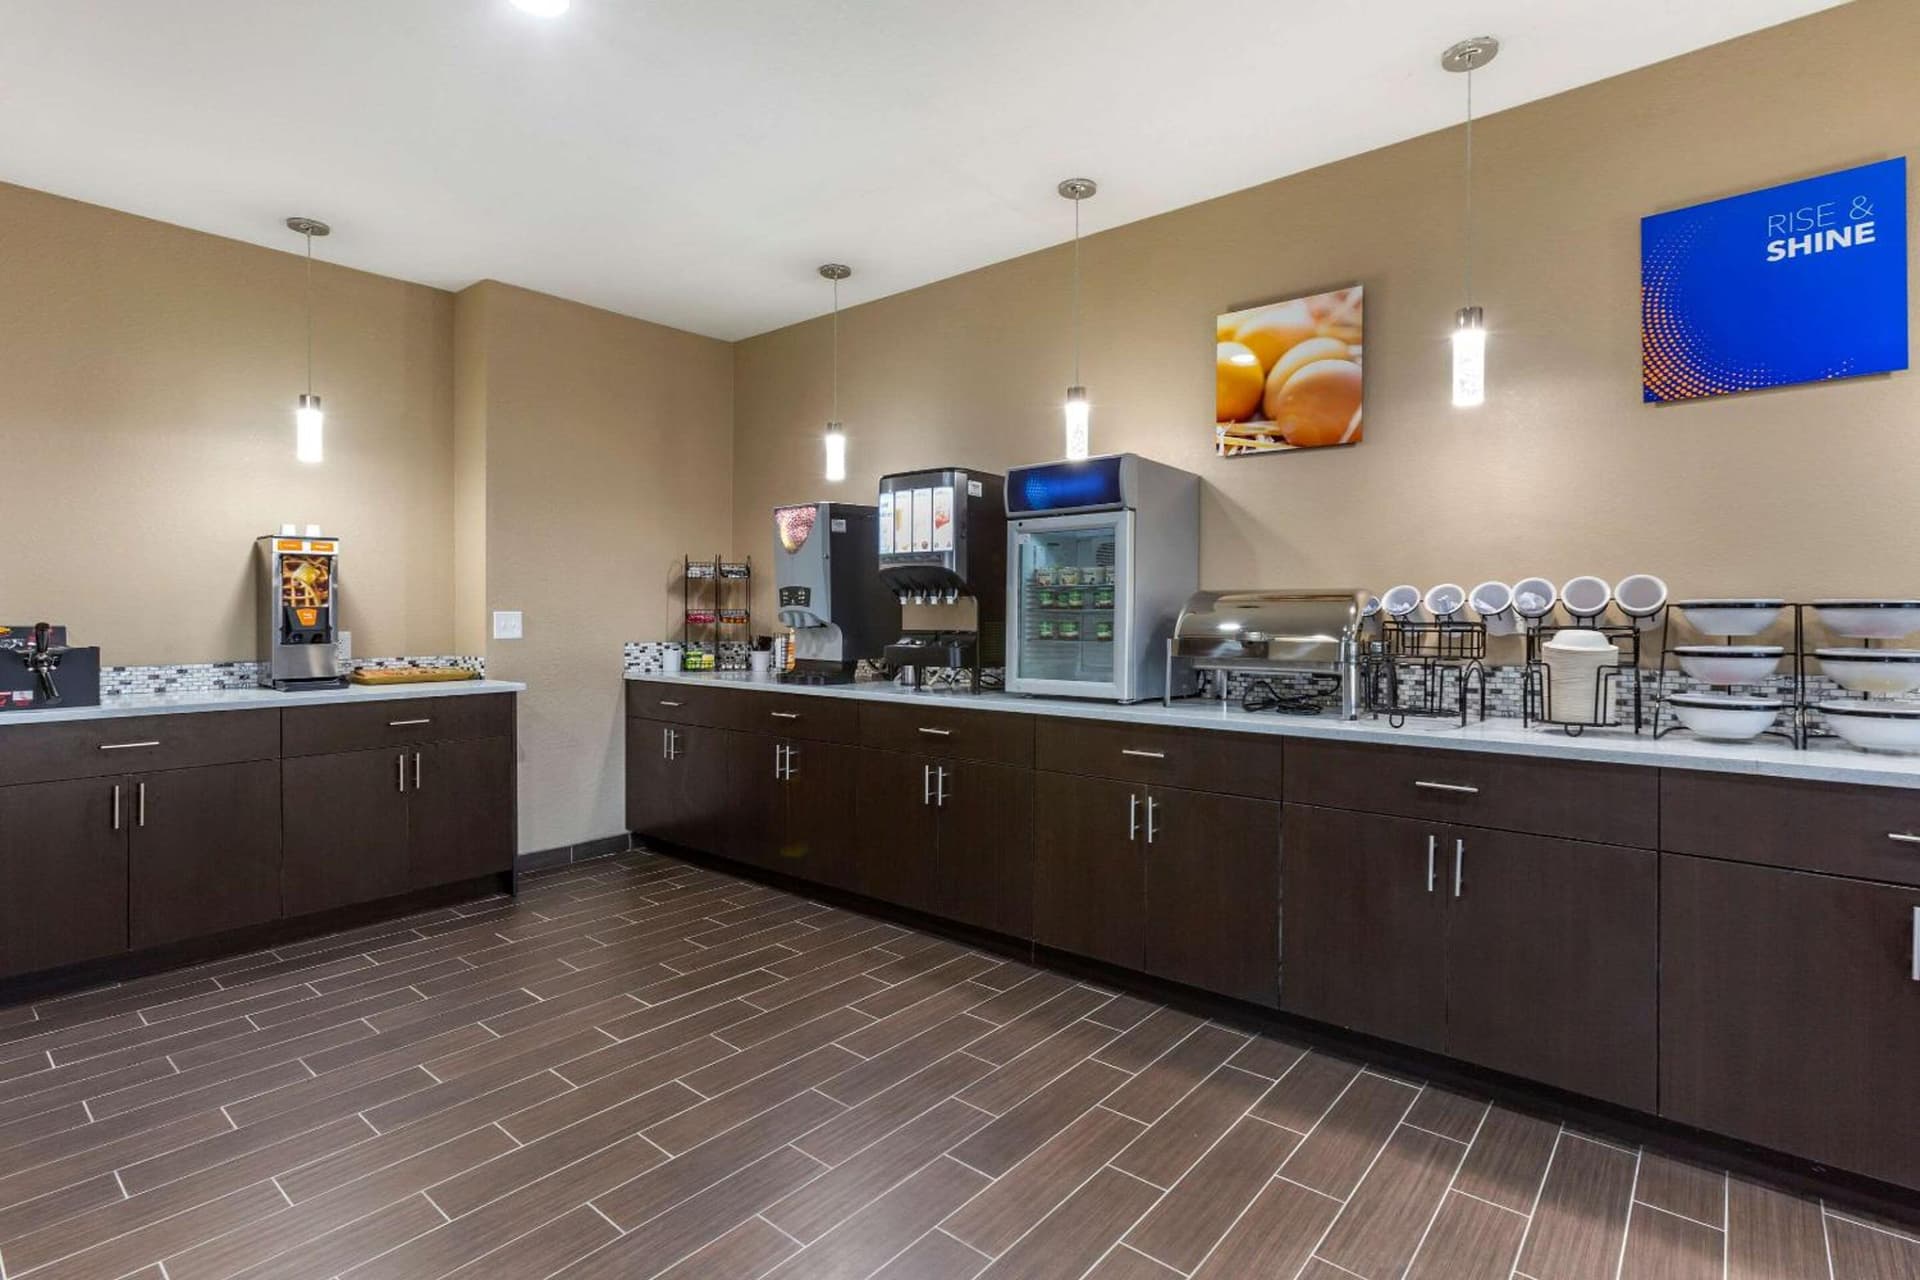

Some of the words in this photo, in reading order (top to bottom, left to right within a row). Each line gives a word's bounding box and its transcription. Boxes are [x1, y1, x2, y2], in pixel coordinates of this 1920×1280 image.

[1767, 202, 1836, 237] RISE
[1849, 195, 1875, 220] &
[1766, 221, 1876, 262] SHINE
